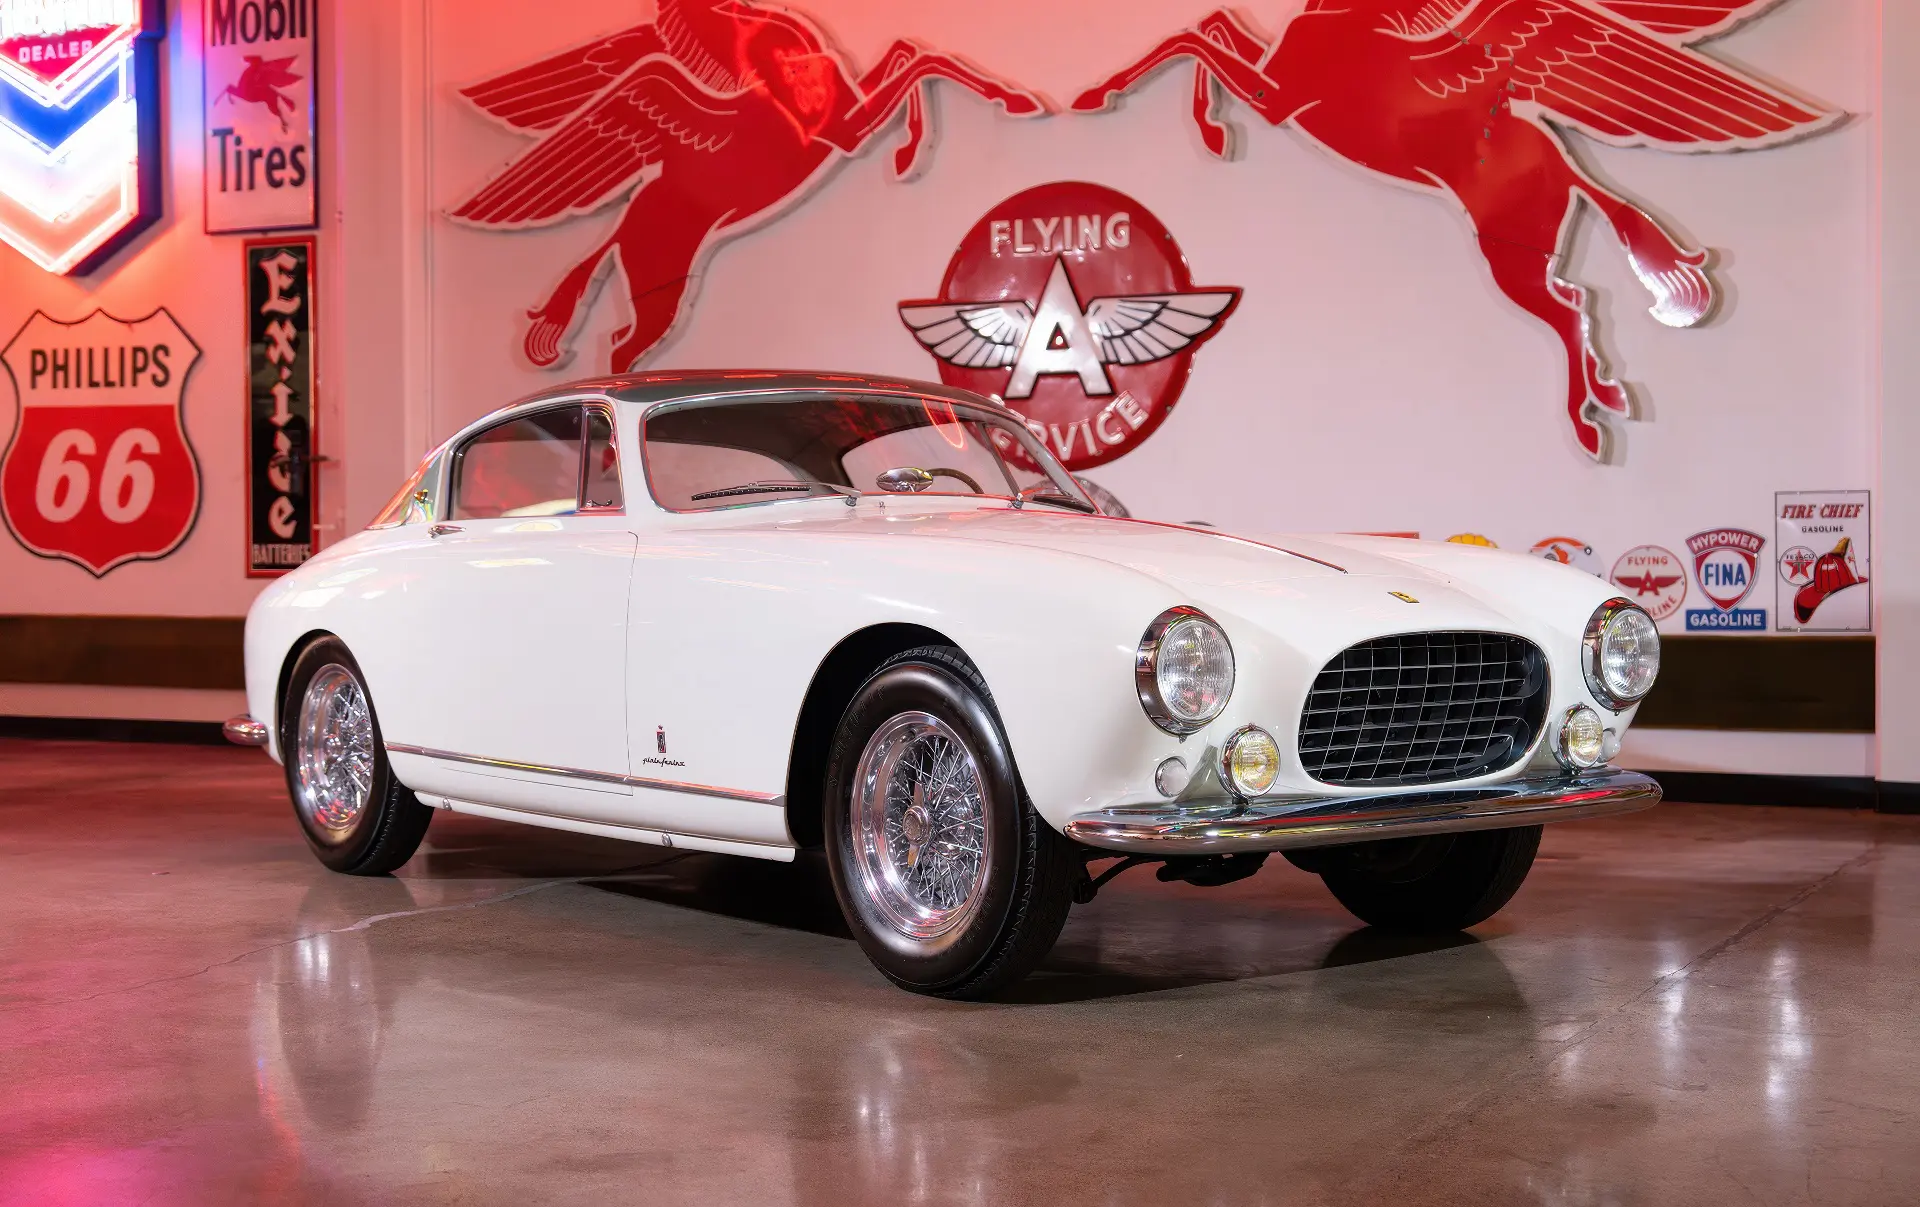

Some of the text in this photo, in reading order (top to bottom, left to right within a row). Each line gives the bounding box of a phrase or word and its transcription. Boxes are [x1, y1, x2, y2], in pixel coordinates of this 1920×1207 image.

[211, 0, 307, 46] Mobil
[18, 40, 93, 64] DEALER
[211, 127, 307, 192] Tires
[990, 212, 1131, 257] FLYING
[30, 344, 171, 390] PHILLIPS
[988, 390, 1150, 464] ERVICE
[35, 427, 161, 524] 66
[1780, 503, 1864, 519] FIRE CHIEF
[1691, 531, 1760, 551] HYPOWER
[1801, 525, 1844, 533] GASOLINE
[1627, 556, 1668, 566] FLYING
[1704, 563, 1746, 586] FINA
[1690, 613, 1762, 627] GASOLINE
